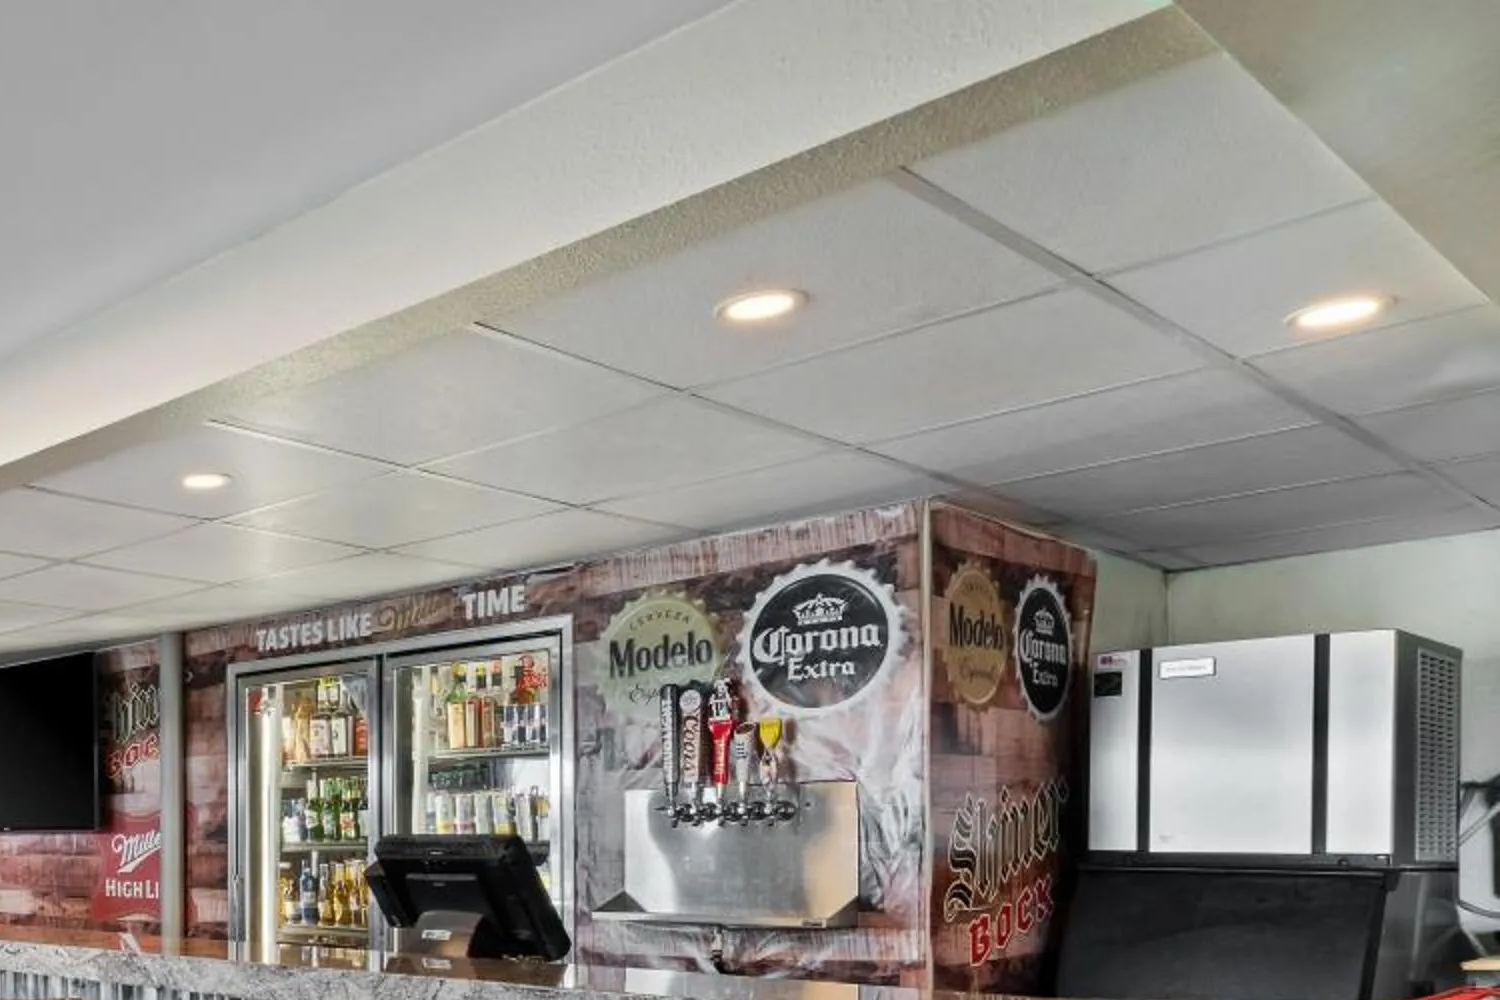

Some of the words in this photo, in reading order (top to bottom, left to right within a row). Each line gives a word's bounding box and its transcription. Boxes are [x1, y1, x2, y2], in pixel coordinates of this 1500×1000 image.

[256, 620, 324, 651] TASTES
[326, 611, 373, 642] LIKE
[461, 584, 526, 620] TIME
[949, 602, 1004, 650] Modelo
[609, 631, 713, 678] Modelo
[753, 624, 882, 666] Corona
[1020, 629, 1066, 664] Corona
[788, 656, 856, 680] Extra
[111, 829, 161, 867] Mille
[105, 878, 143, 898] HIGH
[145, 880, 159, 899] LI
[968, 874, 1054, 967] BOCK
